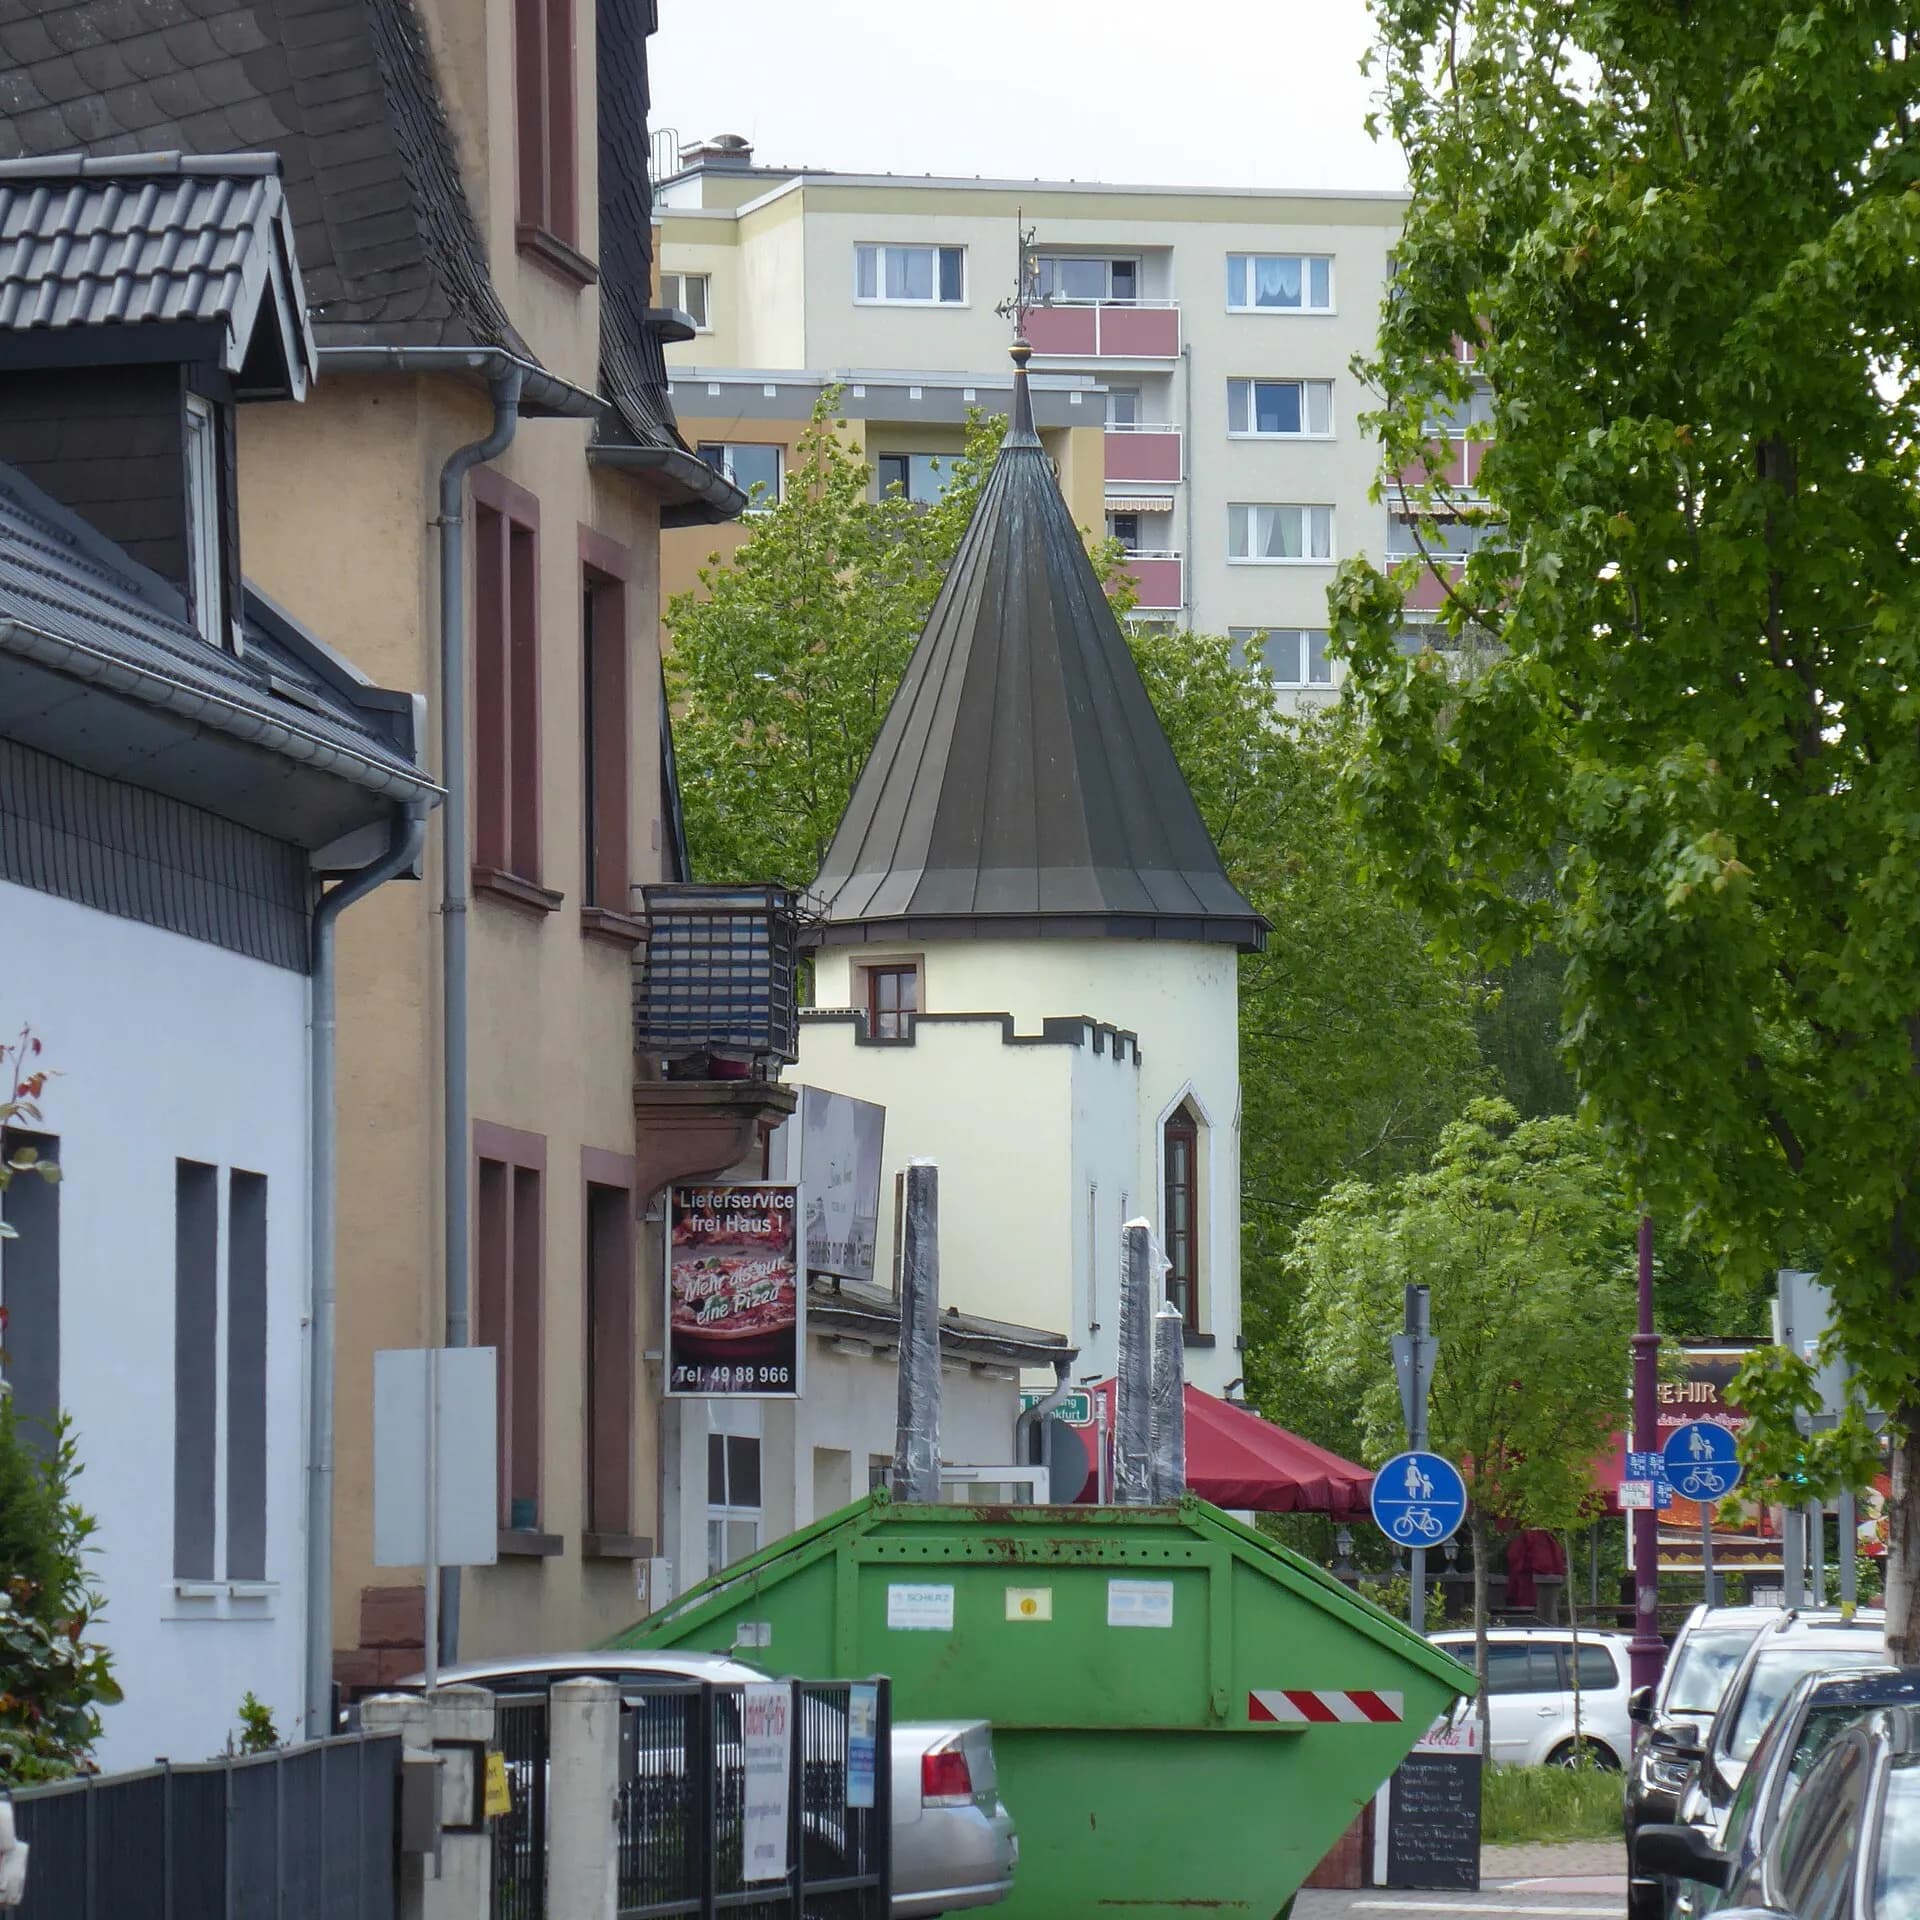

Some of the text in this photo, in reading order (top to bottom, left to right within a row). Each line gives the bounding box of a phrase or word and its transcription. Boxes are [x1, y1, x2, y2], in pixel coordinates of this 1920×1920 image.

[680, 1190, 795, 1209] Lieferservice
[691, 1215, 721, 1233] frei
[726, 1215, 772, 1233] Haus
[684, 1273, 726, 1302] Mehr
[696, 1287, 781, 1326] eine Pizza
[678, 1366, 789, 1383] Tel. 49 88 966
[1657, 1381, 1718, 1404] EHIR
